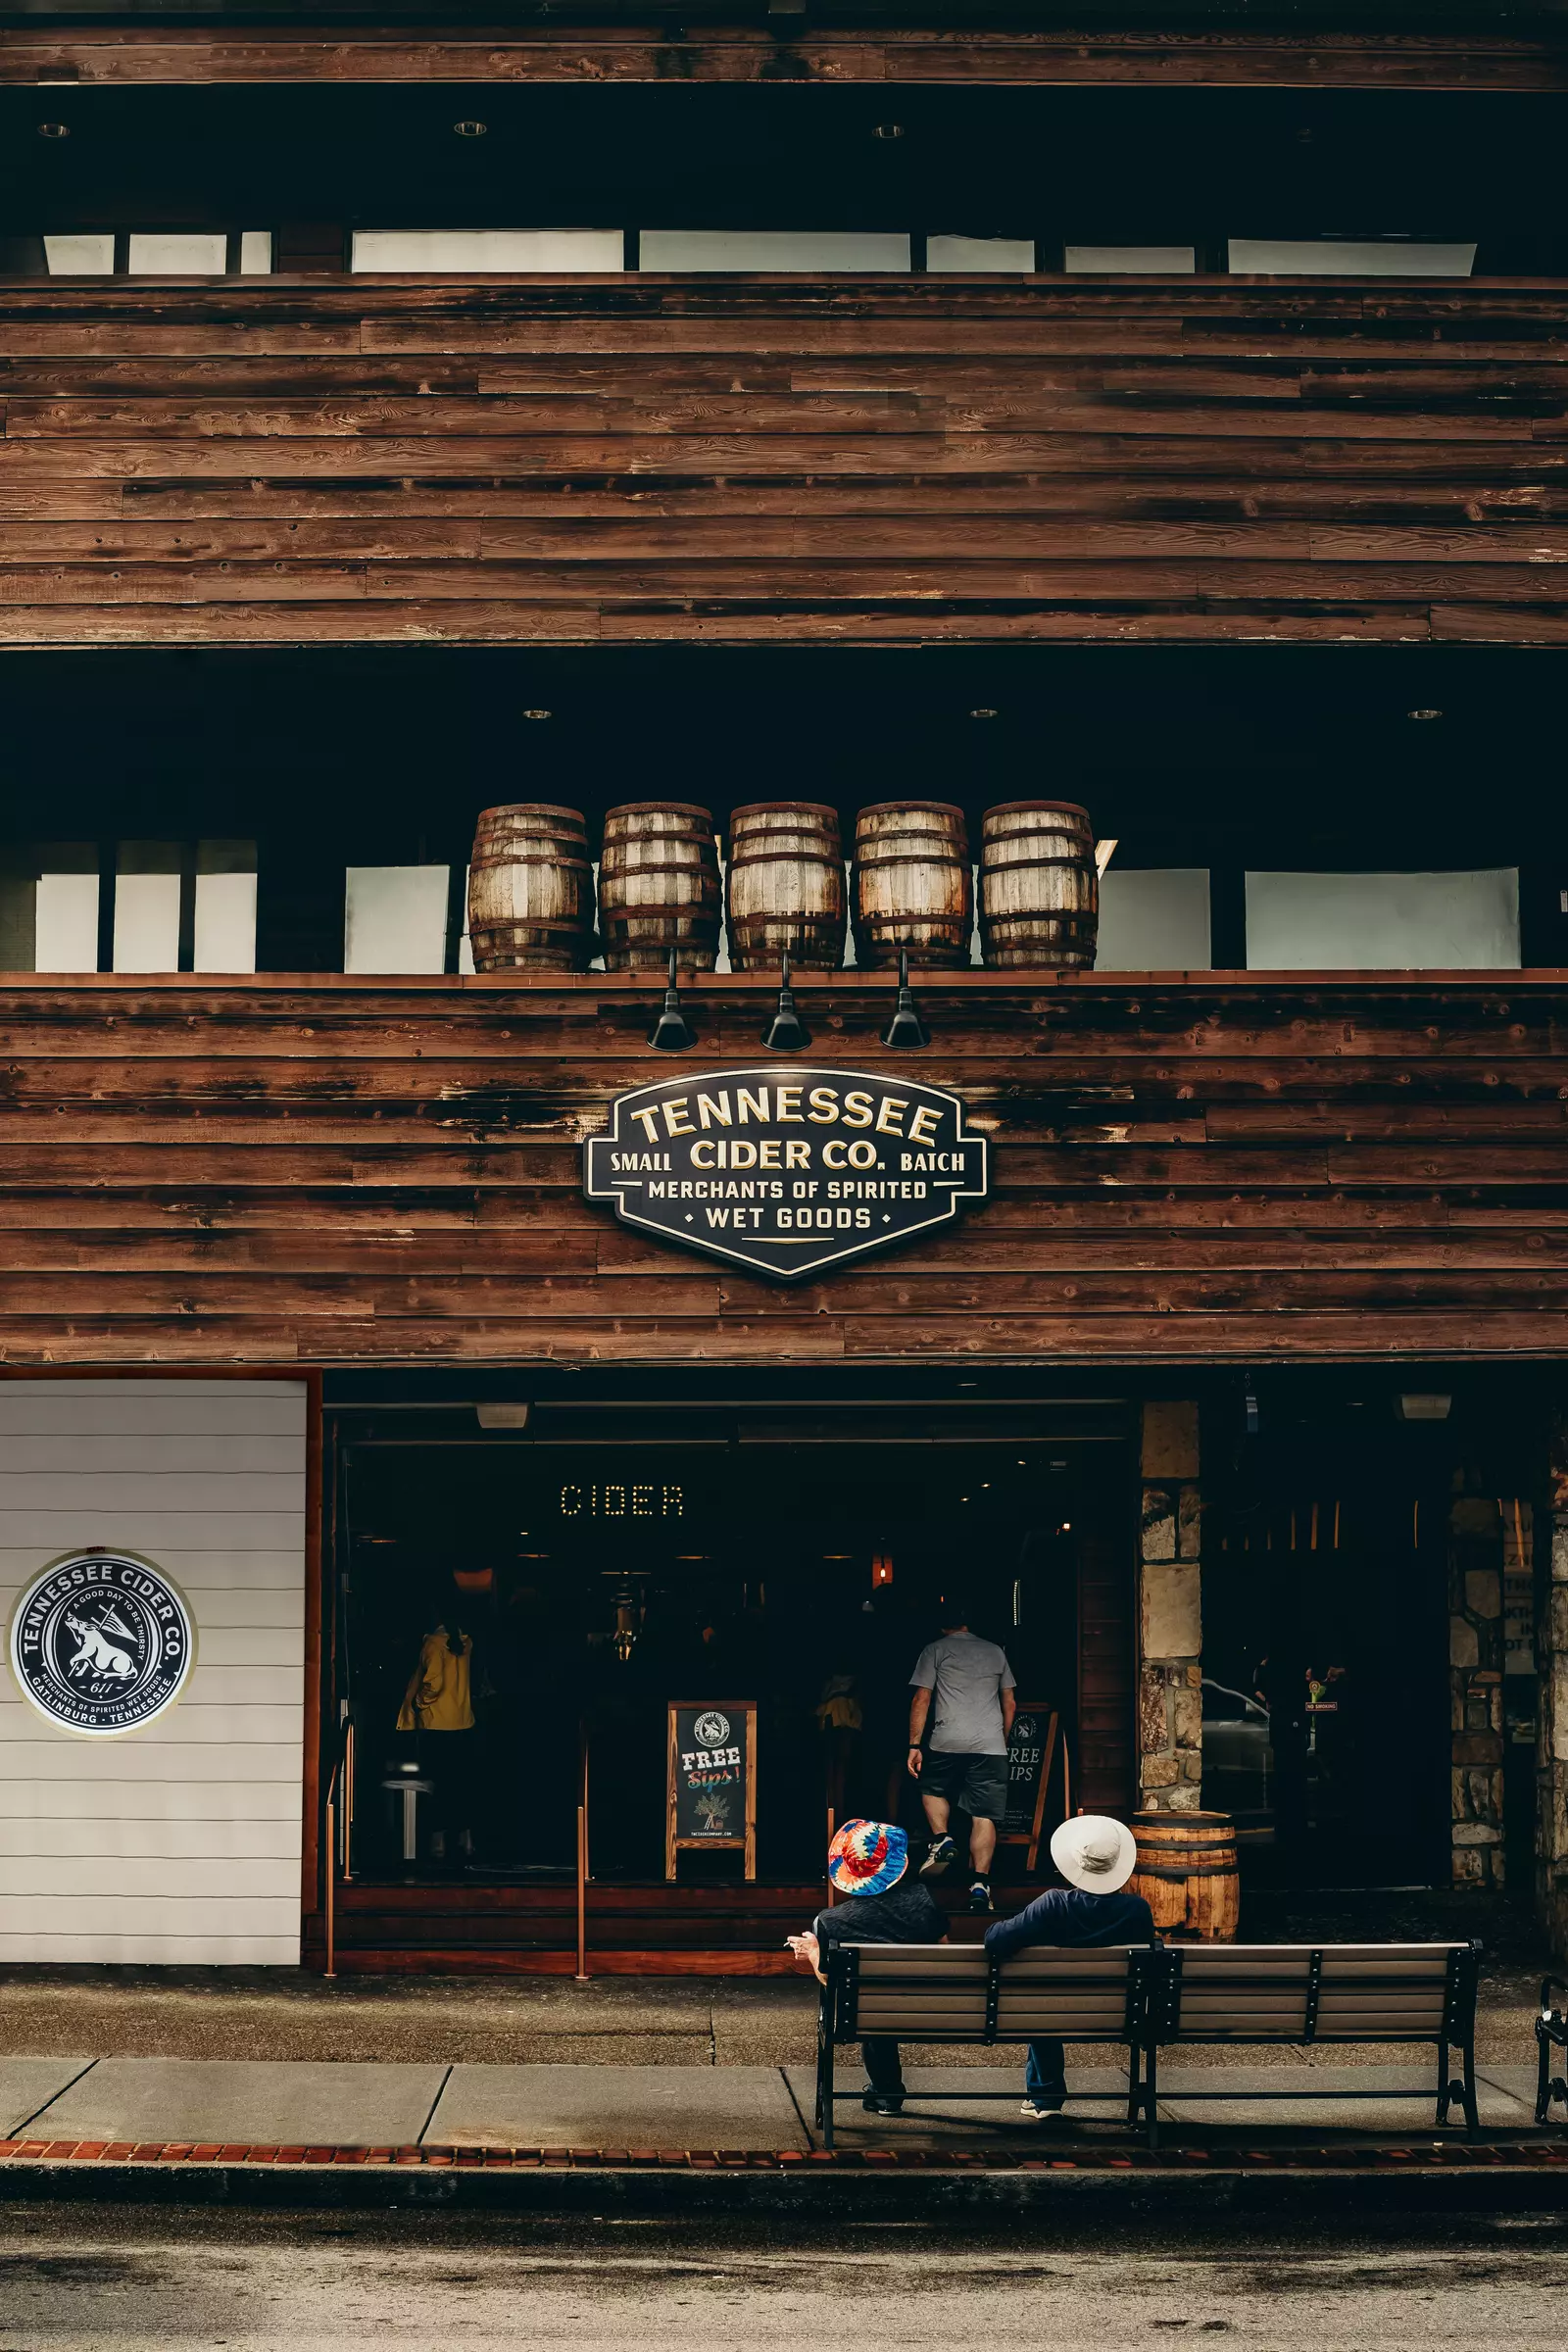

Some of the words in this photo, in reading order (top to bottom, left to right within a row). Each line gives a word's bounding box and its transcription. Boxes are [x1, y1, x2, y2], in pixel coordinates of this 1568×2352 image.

[630, 1086, 945, 1148] TENNESSEE
[612, 1152, 672, 1172] SMALL
[690, 1140, 811, 1170] CIDER
[822, 1140, 885, 1170] CO.
[901, 1152, 964, 1172] BATCH
[648, 1181, 783, 1200] MERCHANTS
[793, 1181, 818, 1200] OF
[827, 1181, 926, 1200] SPIRITED
[706, 1207, 764, 1229] WET
[776, 1207, 871, 1229] GOODS
[561, 1485, 683, 1516] CIDER
[24, 1565, 113, 1653] TENNESSEE
[121, 1569, 173, 1621] CIDER
[165, 1626, 180, 1661] CO.
[79, 1590, 104, 1603] GOOD
[107, 1591, 123, 1601] DAY
[123, 1599, 133, 1611] TO
[131, 1611, 141, 1623] BE
[137, 1624, 146, 1661] THIRSTY
[32, 1677, 97, 1724] GATLINBURG
[110, 1678, 172, 1723] TENNESSEE
[41, 1673, 76, 1707] MERCHANTS
[90, 1702, 125, 1713] SPIRITED
[127, 1695, 142, 1707] WET
[142, 1675, 162, 1697] GOODS
[90, 1682, 114, 1693] 611
[682, 1747, 741, 1771] FREE
[1006, 1747, 1040, 1763] REE
